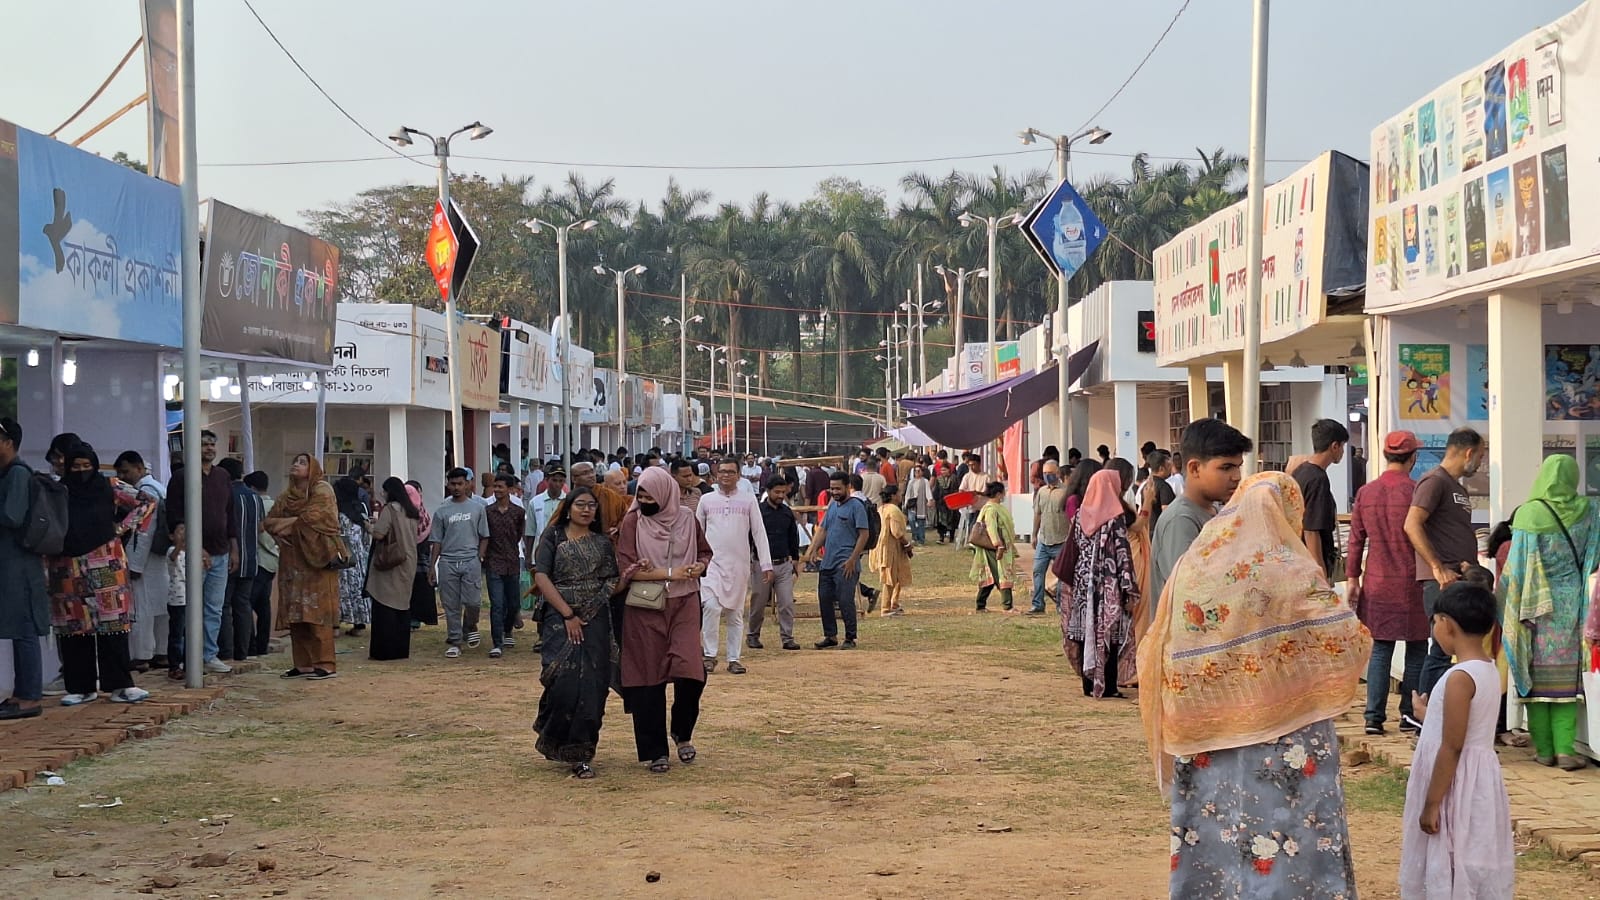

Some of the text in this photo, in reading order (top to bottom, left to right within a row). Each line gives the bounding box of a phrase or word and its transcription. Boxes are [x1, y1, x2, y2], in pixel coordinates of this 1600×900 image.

[64, 234, 178, 306] কাকলী প্রকাশনী
[236, 243, 292, 312] জোনাকী
[351, 364, 390, 378] নিচতলা
